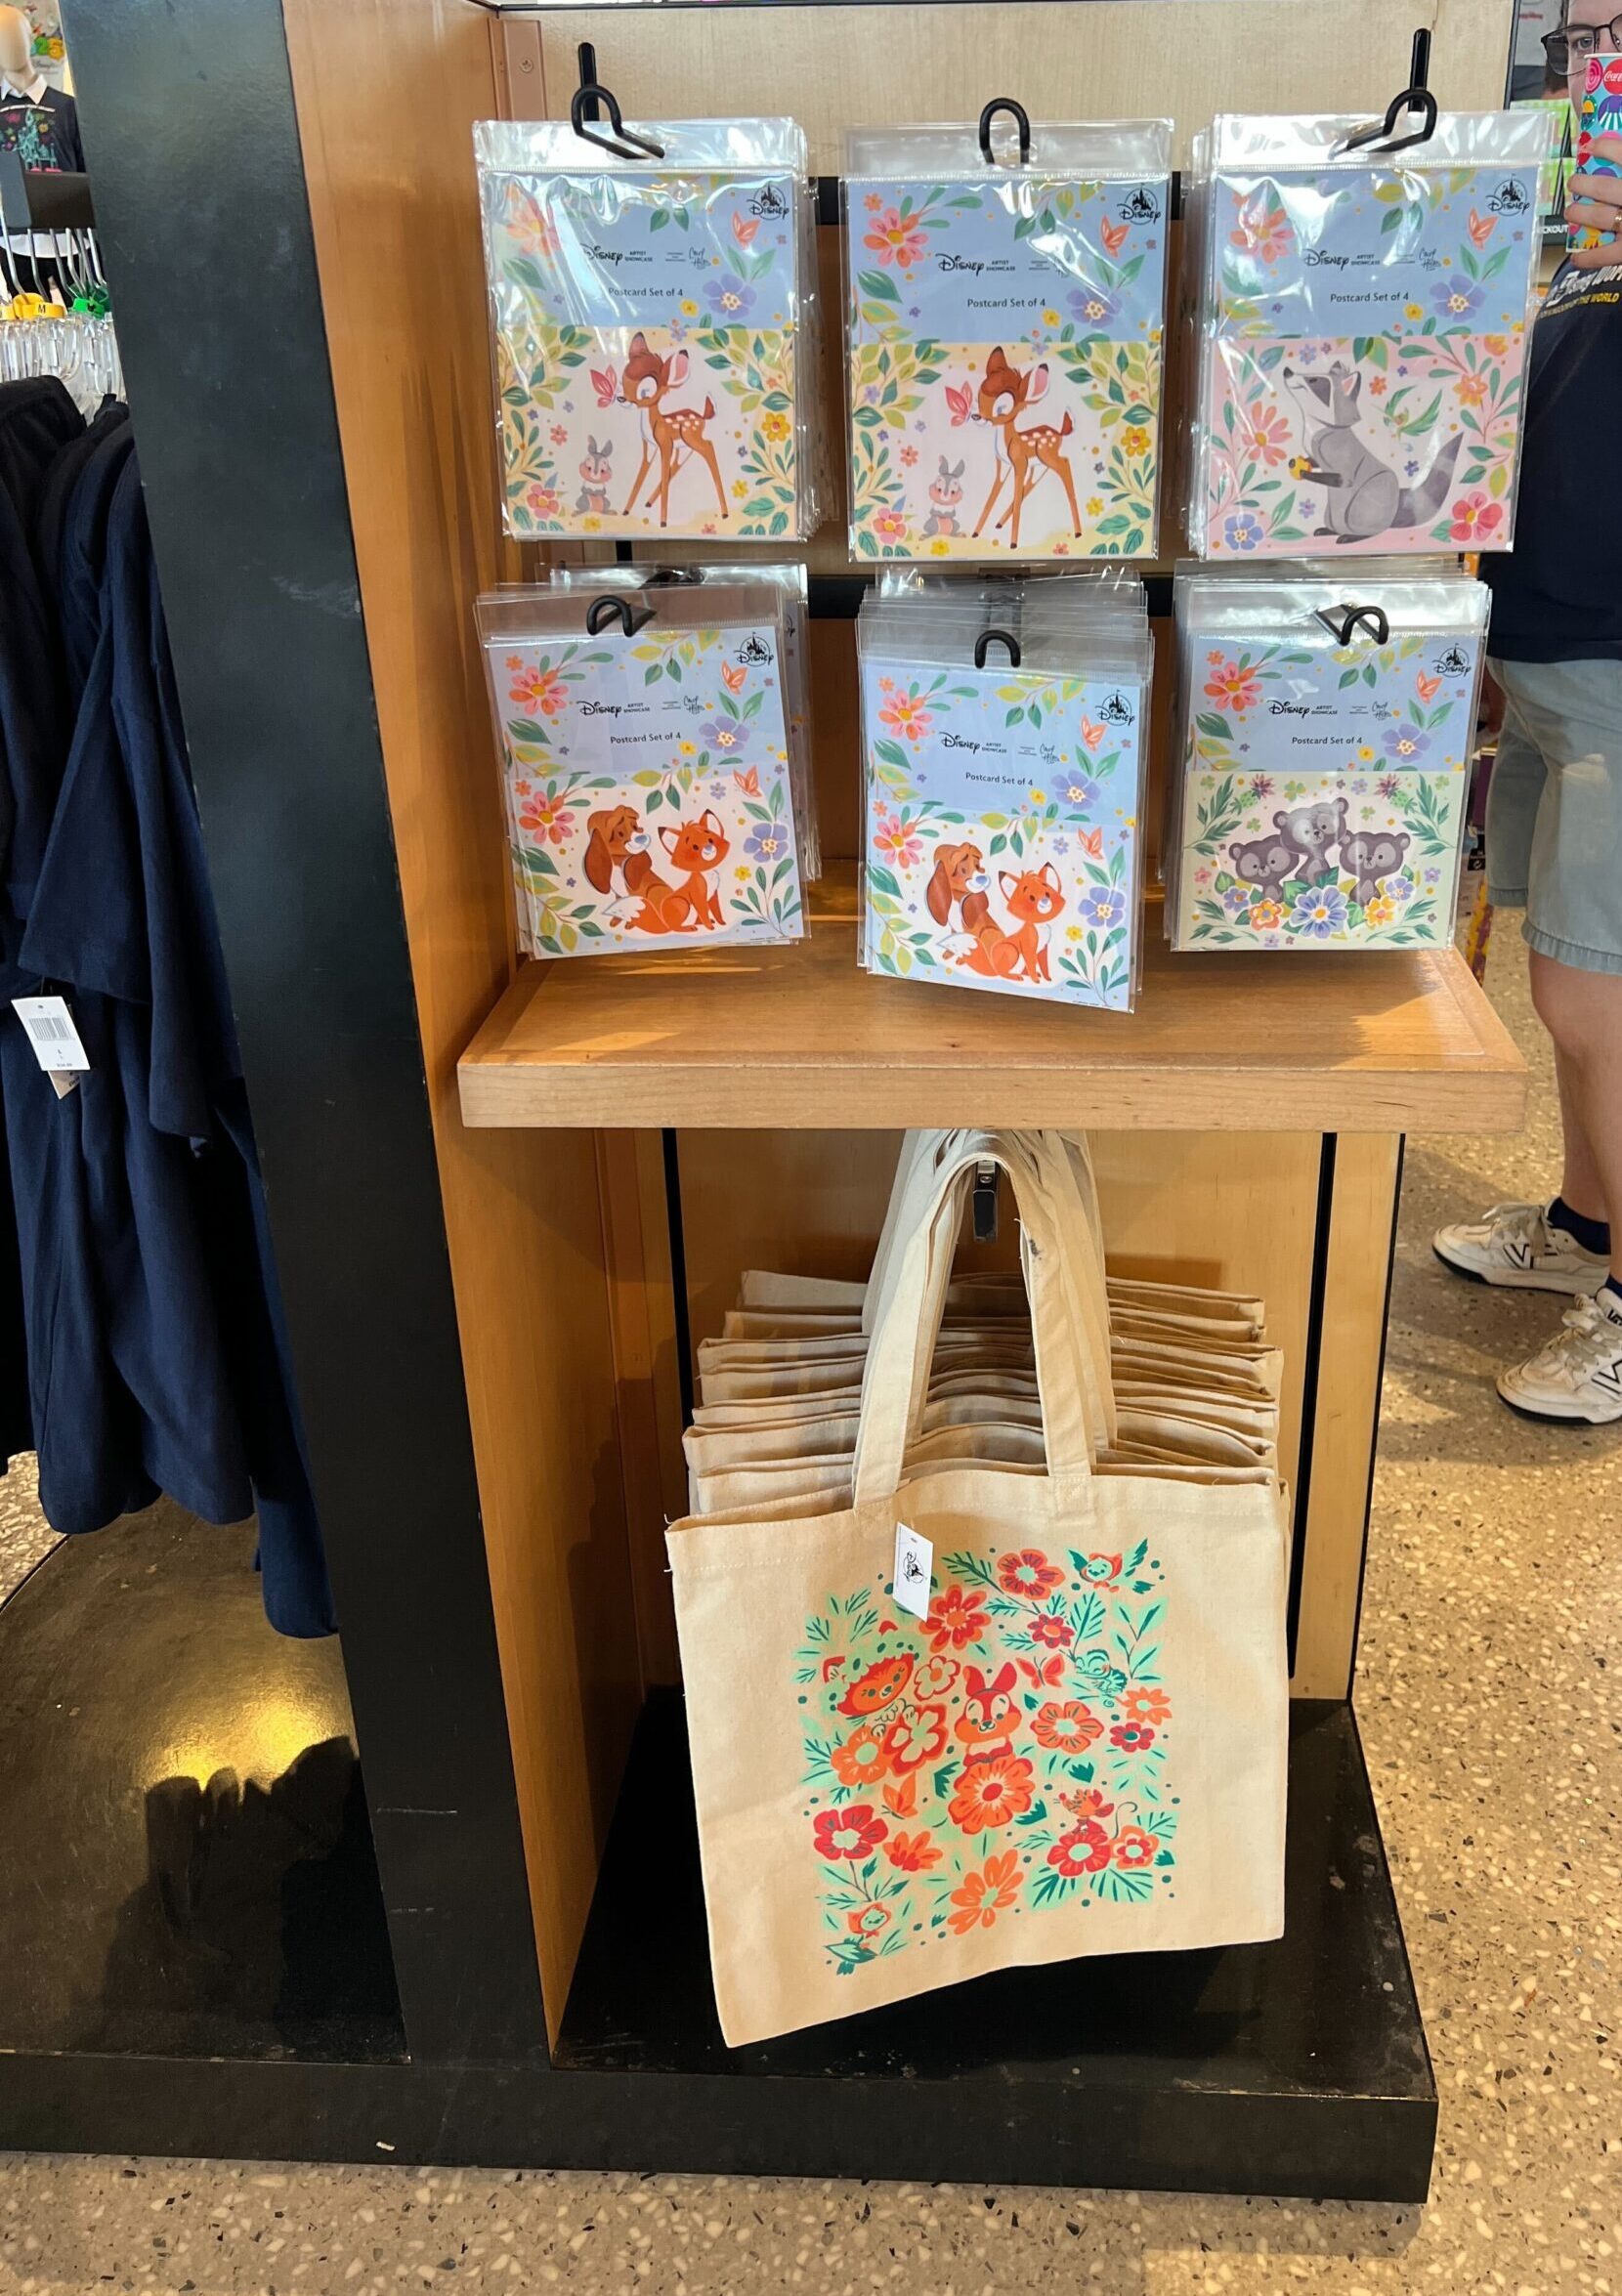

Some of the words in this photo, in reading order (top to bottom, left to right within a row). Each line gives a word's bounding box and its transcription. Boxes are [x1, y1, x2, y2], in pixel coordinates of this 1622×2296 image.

[746, 198, 790, 220] Disney
[1485, 194, 1531, 215] Disney
[1117, 202, 1162, 225] Disney
[579, 242, 623, 266] Disney
[1302, 248, 1350, 271] Disney
[935, 253, 985, 276] Disney
[608, 287, 647, 297] Postcard
[649, 287, 664, 297] Set
[665, 287, 678, 297] of
[677, 288, 684, 297] 4
[1330, 293, 1371, 303] Postcard
[1373, 292, 1388, 302] Set
[1389, 292, 1402, 302] of
[1402, 292, 1409, 301] 4
[1591, 292, 1620, 304] WORLD
[966, 298, 1007, 308] Postcard
[1009, 298, 1026, 308] Set
[1026, 298, 1039, 308] of
[1039, 298, 1046, 307] 4
[733, 648, 775, 665] Disney
[1430, 659, 1472, 675] Disney
[576, 701, 622, 717] Disney
[1094, 704, 1135, 725] Disney
[1266, 700, 1310, 719] Disney
[610, 734, 647, 744] Postcard
[649, 734, 663, 743] Set
[663, 732, 674, 742] of
[674, 732, 682, 741] 4
[939, 731, 981, 754] Disney
[1345, 736, 1356, 744] of
[965, 772, 1001, 784] Postcard
[1002, 775, 1016, 785] Set
[1016, 777, 1028, 786] of
[1027, 778, 1034, 787] 4
